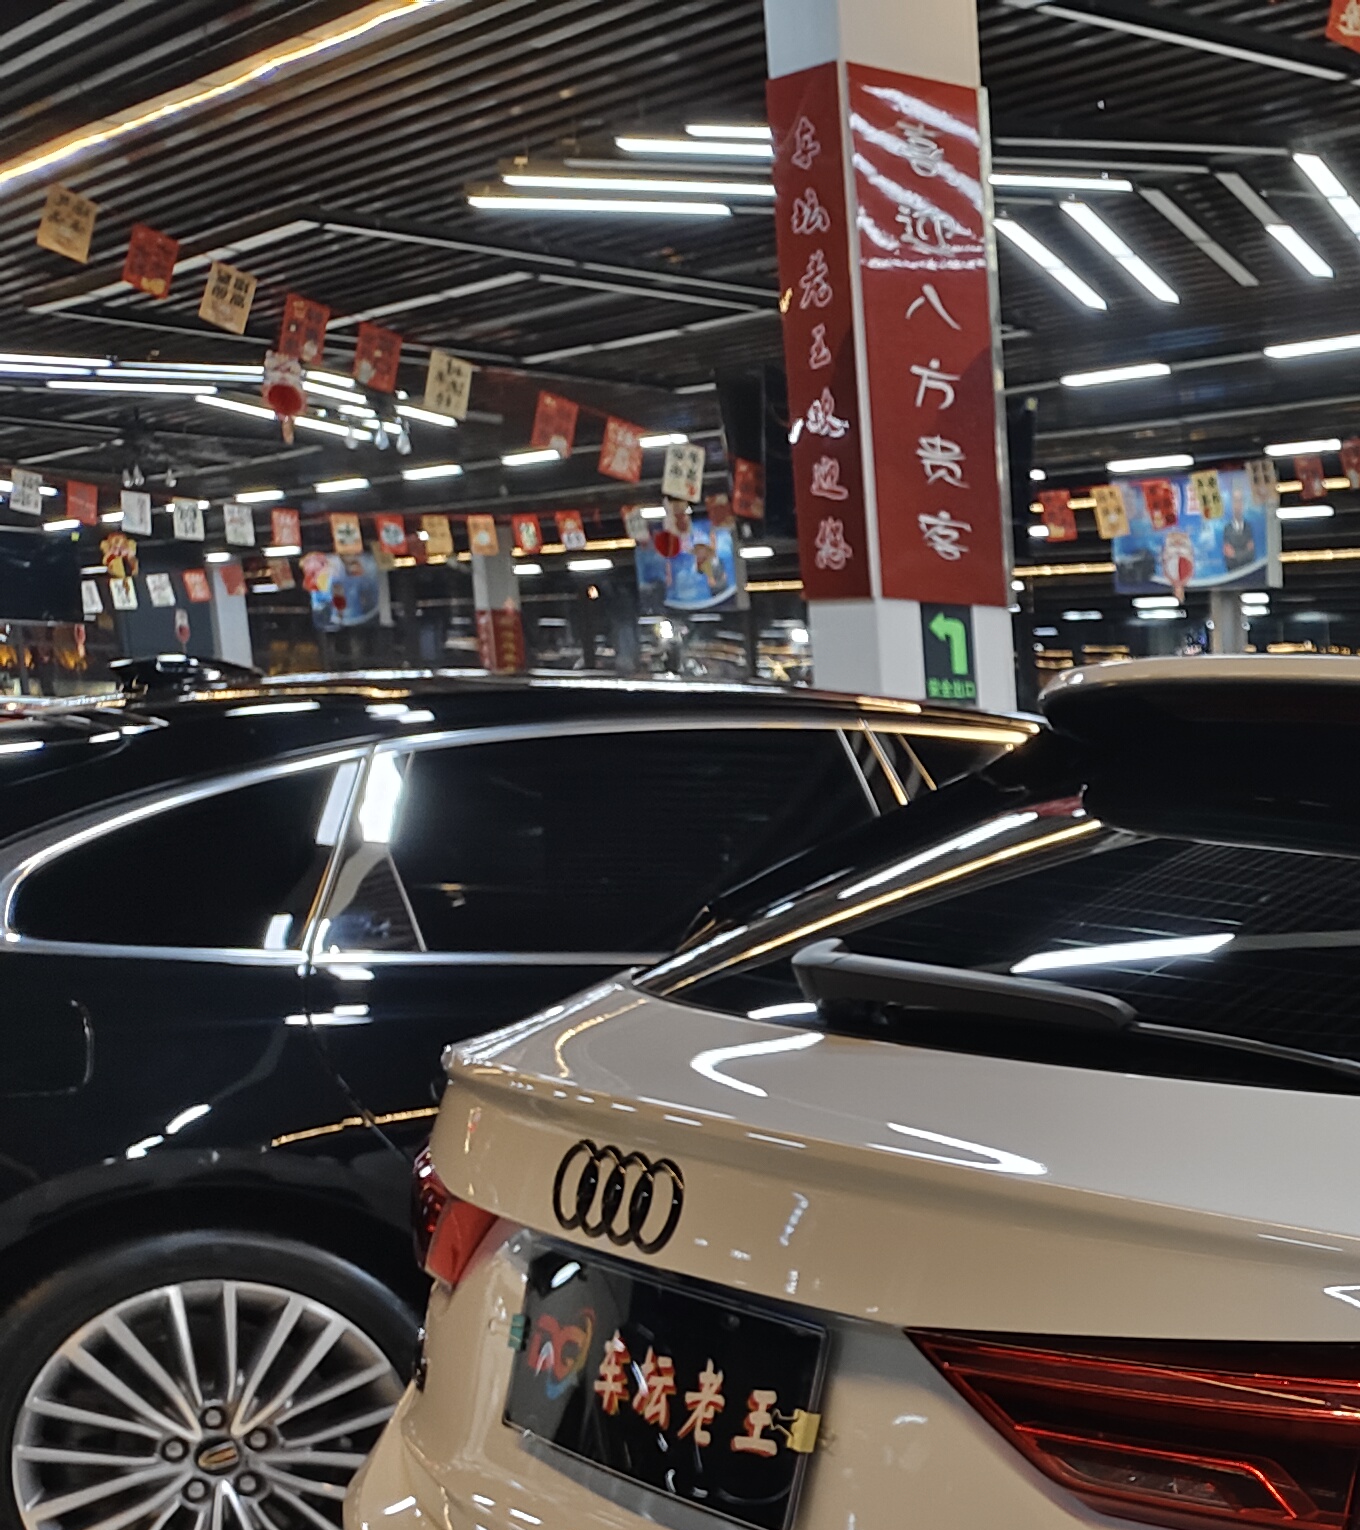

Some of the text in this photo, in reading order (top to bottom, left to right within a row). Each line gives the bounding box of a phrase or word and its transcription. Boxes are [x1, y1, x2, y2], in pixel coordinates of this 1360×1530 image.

[895, 120, 972, 561] 喜迎八方贵客
[593, 1328, 779, 1458] 车坛老王
